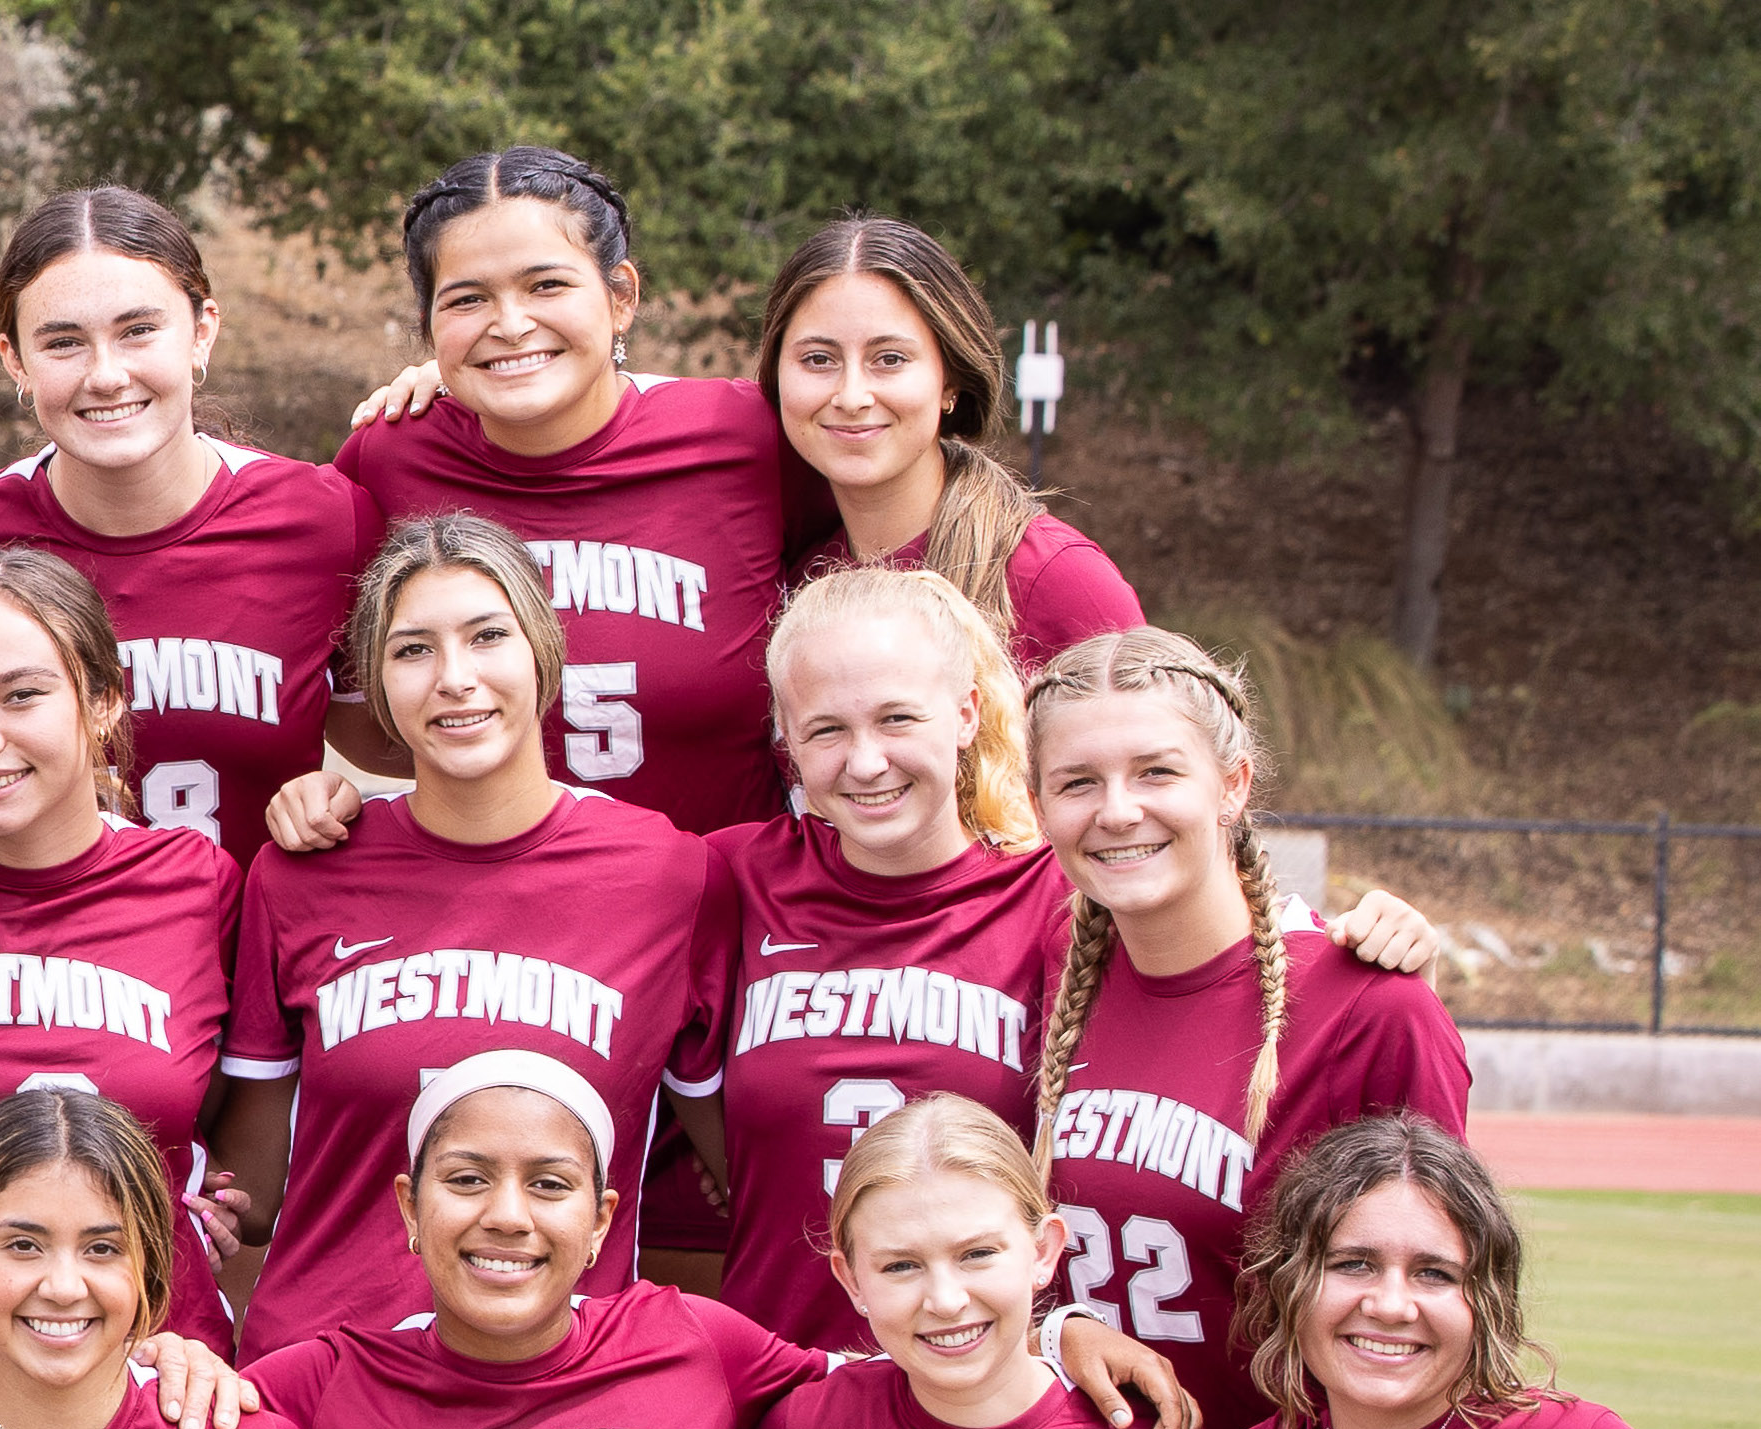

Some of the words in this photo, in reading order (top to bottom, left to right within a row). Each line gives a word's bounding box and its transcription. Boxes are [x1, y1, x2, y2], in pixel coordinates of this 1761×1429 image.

[527, 540, 708, 633] MONT
[116, 637, 284, 726] MONT
[317, 948, 624, 1061] WESTMONT
[735, 965, 1028, 1074] WESTMONT
[1035, 1088, 1256, 1214] ESTMONT
[1056, 1202, 1205, 1343] 22
